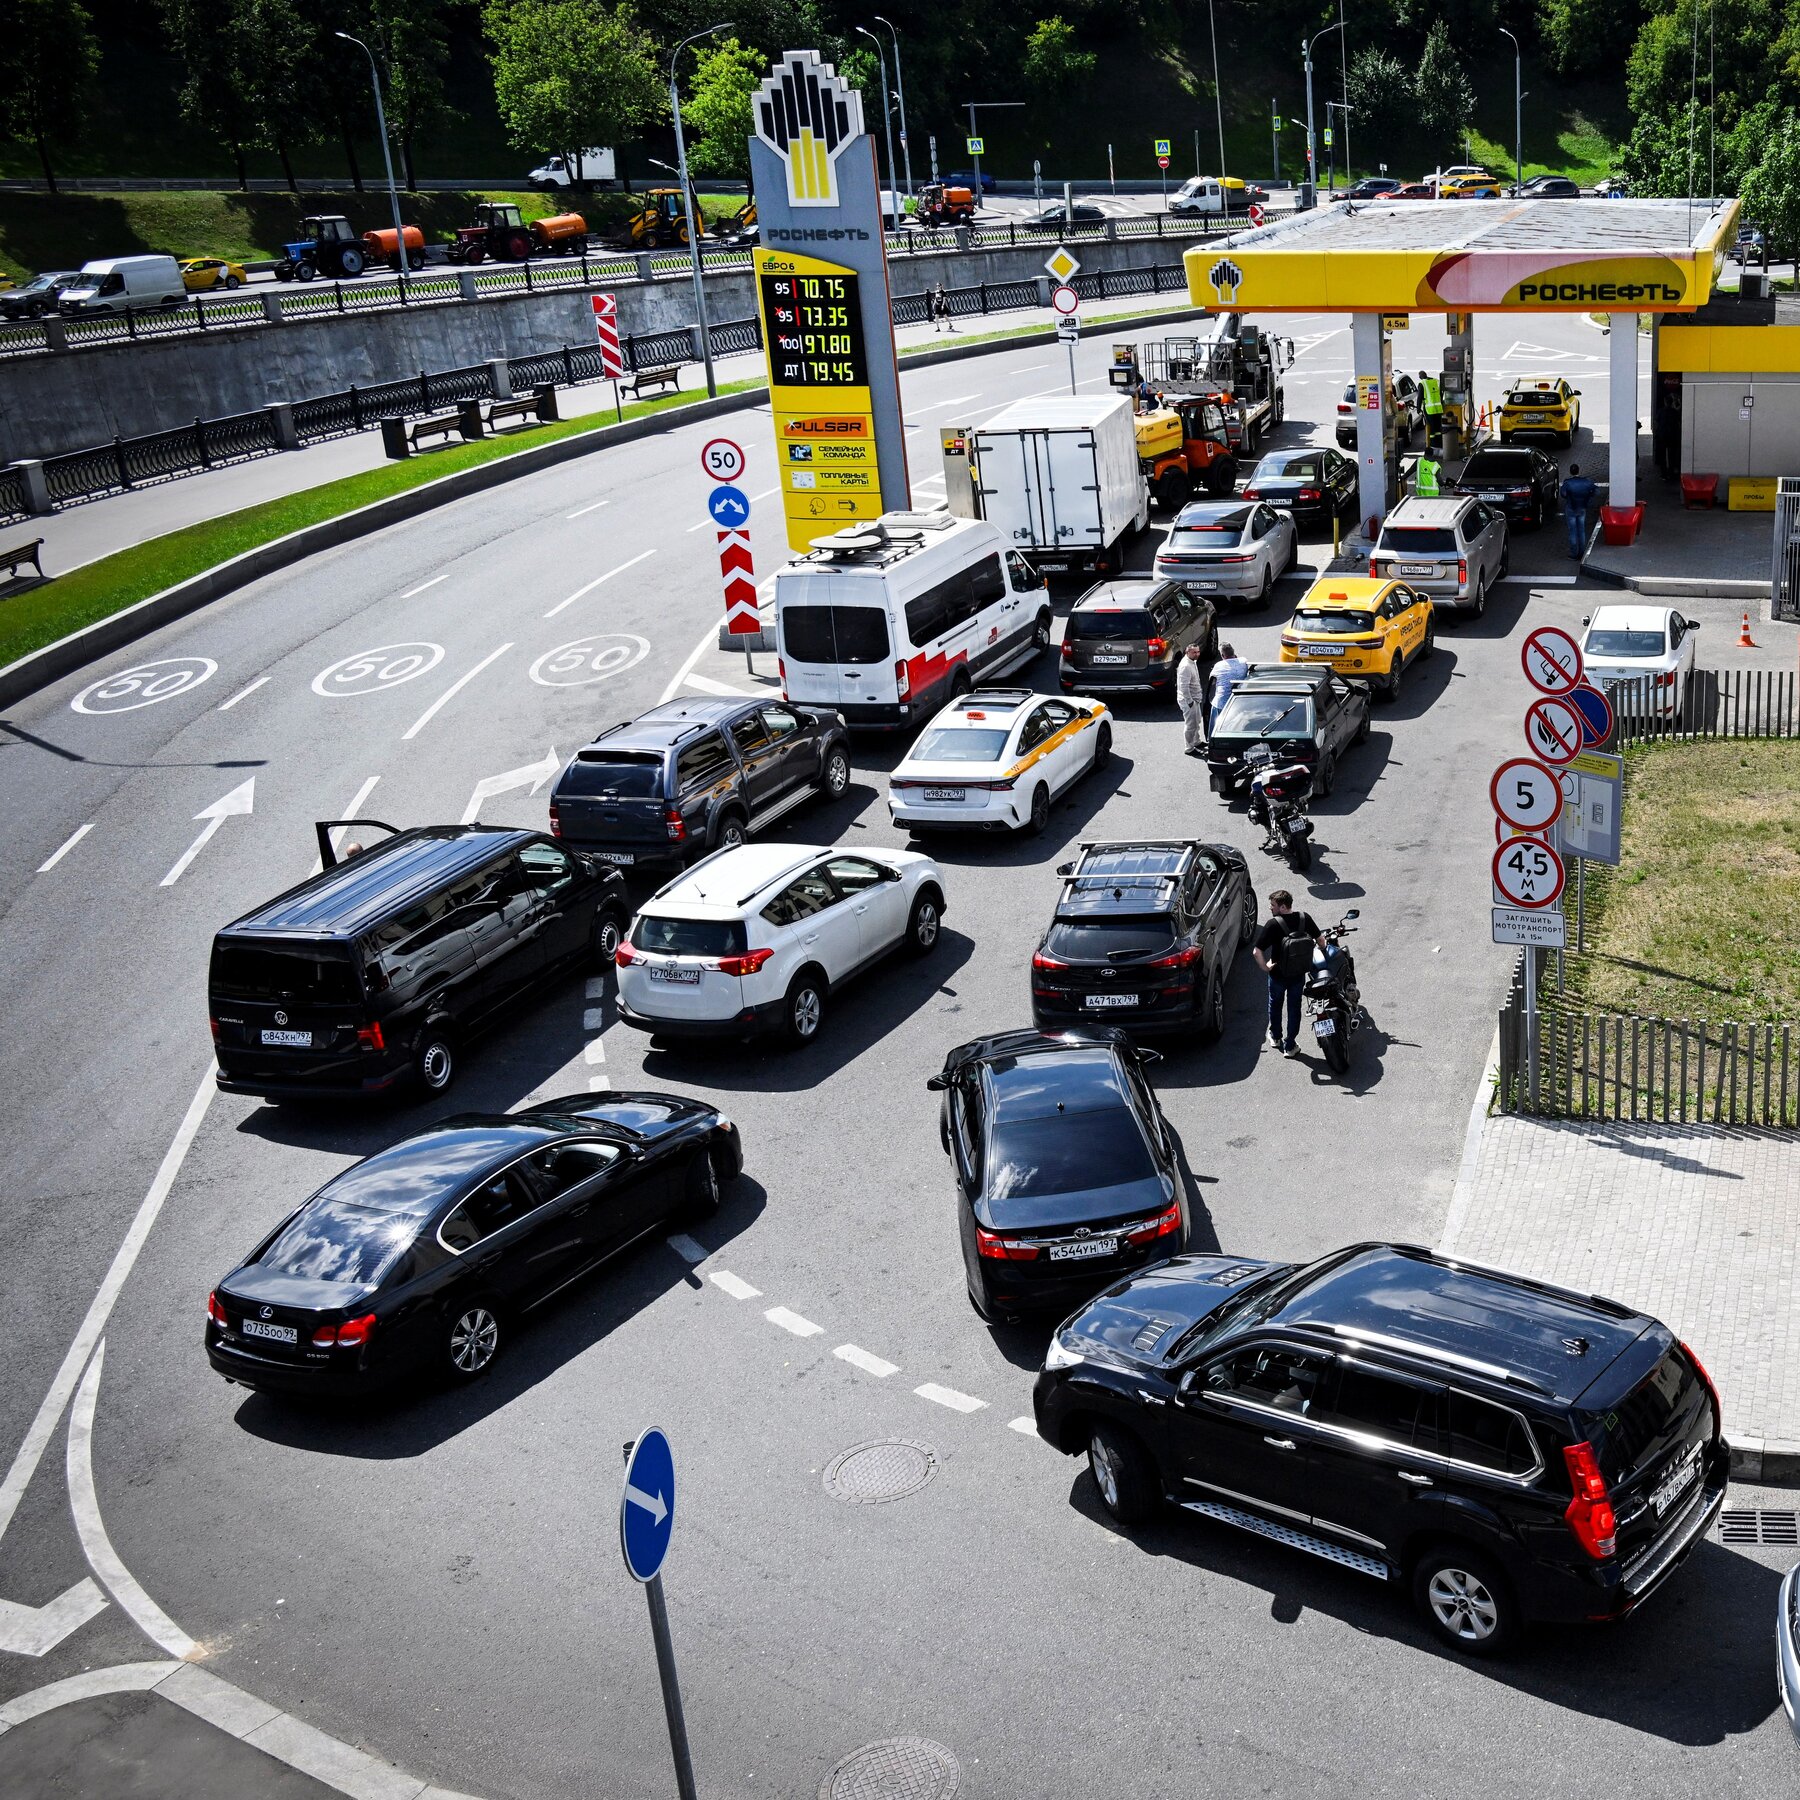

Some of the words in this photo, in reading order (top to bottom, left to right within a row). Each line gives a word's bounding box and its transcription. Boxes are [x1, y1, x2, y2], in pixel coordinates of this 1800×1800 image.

[767, 228, 870, 242] РОСНЕФТЬ
[762, 262, 788, 270] ЕВРО
[789, 262, 795, 270] 6
[775, 283, 790, 294] 95
[800, 279, 845, 299] 70.75
[1519, 283, 1681, 301] РОСНЕФТЬ
[778, 310, 793, 322] 95
[803, 306, 848, 326] 73.35
[781, 338, 799, 350] 100
[804, 334, 851, 354] 97.80
[784, 364, 799, 376] ДТ
[808, 361, 854, 382] 79.45
[957, 429, 966, 438] 5
[711, 452, 735, 468] 50
[335, 656, 423, 682] 50
[548, 647, 631, 672] 50
[97, 670, 186, 698] 50
[1516, 781, 1535, 810] 5
[1507, 850, 1548, 877] 4,5
[1495, 922, 1563, 934] МОТОТРАНСПОРТ
[1505, 914, 1552, 924] ЗАГЛУШИТЬ
[1515, 932, 1526, 940] ЗА
